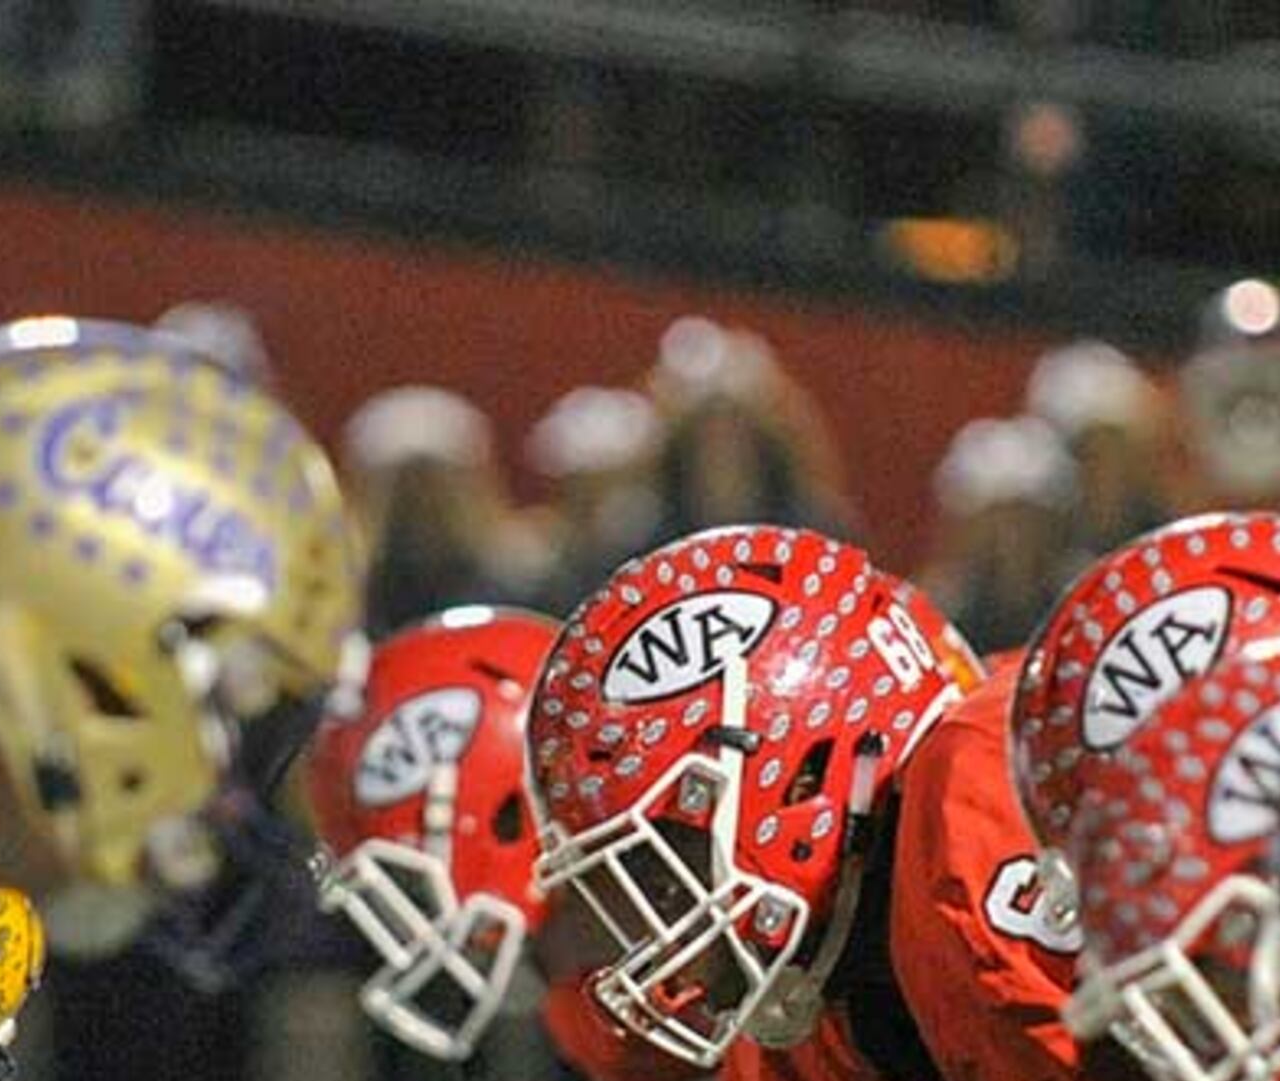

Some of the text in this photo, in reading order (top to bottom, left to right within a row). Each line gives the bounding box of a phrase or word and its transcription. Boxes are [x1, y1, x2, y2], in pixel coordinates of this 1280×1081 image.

[618, 604, 756, 685] WA
[867, 603, 935, 690] 68
[1090, 614, 1217, 722] WA
[360, 710, 469, 785] WA
